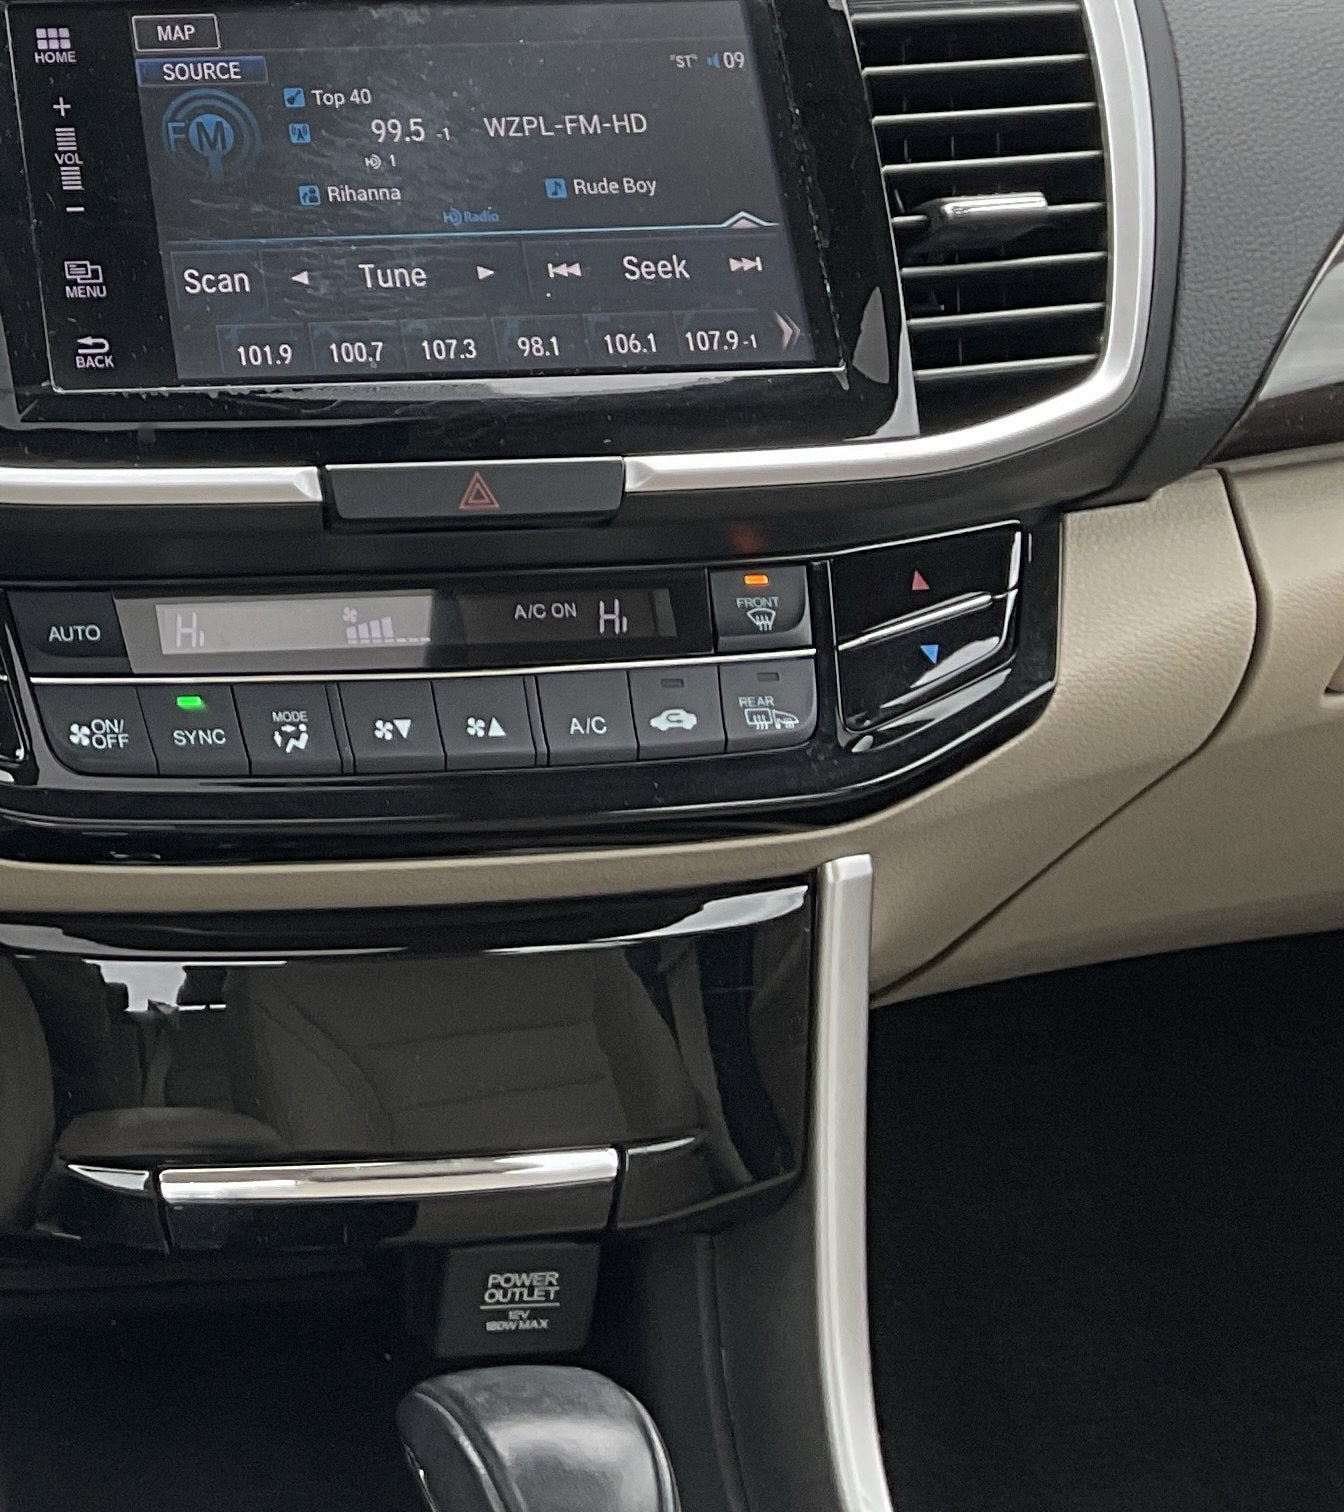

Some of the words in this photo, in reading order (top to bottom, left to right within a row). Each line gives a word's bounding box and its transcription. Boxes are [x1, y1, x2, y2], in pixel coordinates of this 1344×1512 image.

[156, 24, 196, 42] MAP
[34, 50, 77, 64] HOME
[723, 52, 745, 68] 09
[162, 61, 242, 81] SOURCE
[312, 89, 345, 107] Top
[349, 88, 372, 105] 40
[370, 118, 426, 143] 99.5
[483, 113, 648, 138] WZPL-FM-HD
[55, 152, 83, 165] VOL
[327, 185, 402, 203] Rihanna
[573, 178, 619, 195] Rude
[623, 177, 657, 197] Boy
[463, 209, 500, 224] Radio
[358, 263, 427, 289] Tune
[622, 255, 690, 280] Seek
[183, 268, 250, 294] Scan
[65, 285, 107, 299] MENU
[421, 338, 477, 360] 107.3
[518, 335, 560, 357] 98.1
[604, 333, 657, 355] 106.1
[685, 330, 738, 351] 107.9
[237, 343, 292, 366] 101.9
[329, 341, 384, 363] 100.7
[75, 355, 114, 369] BACK
[514, 603, 547, 621] A/C
[551, 601, 577, 619] ON
[735, 596, 779, 609] FRONT
[48, 624, 101, 643] AUTO
[738, 695, 775, 708] REAR
[272, 710, 309, 723] MODE
[569, 715, 608, 736] A/C
[91, 718, 125, 736] ON/
[91, 733, 129, 750] OFF
[172, 728, 226, 747] SYNC
[488, 1271, 560, 1288] POWER
[483, 1286, 560, 1303] OUTLET
